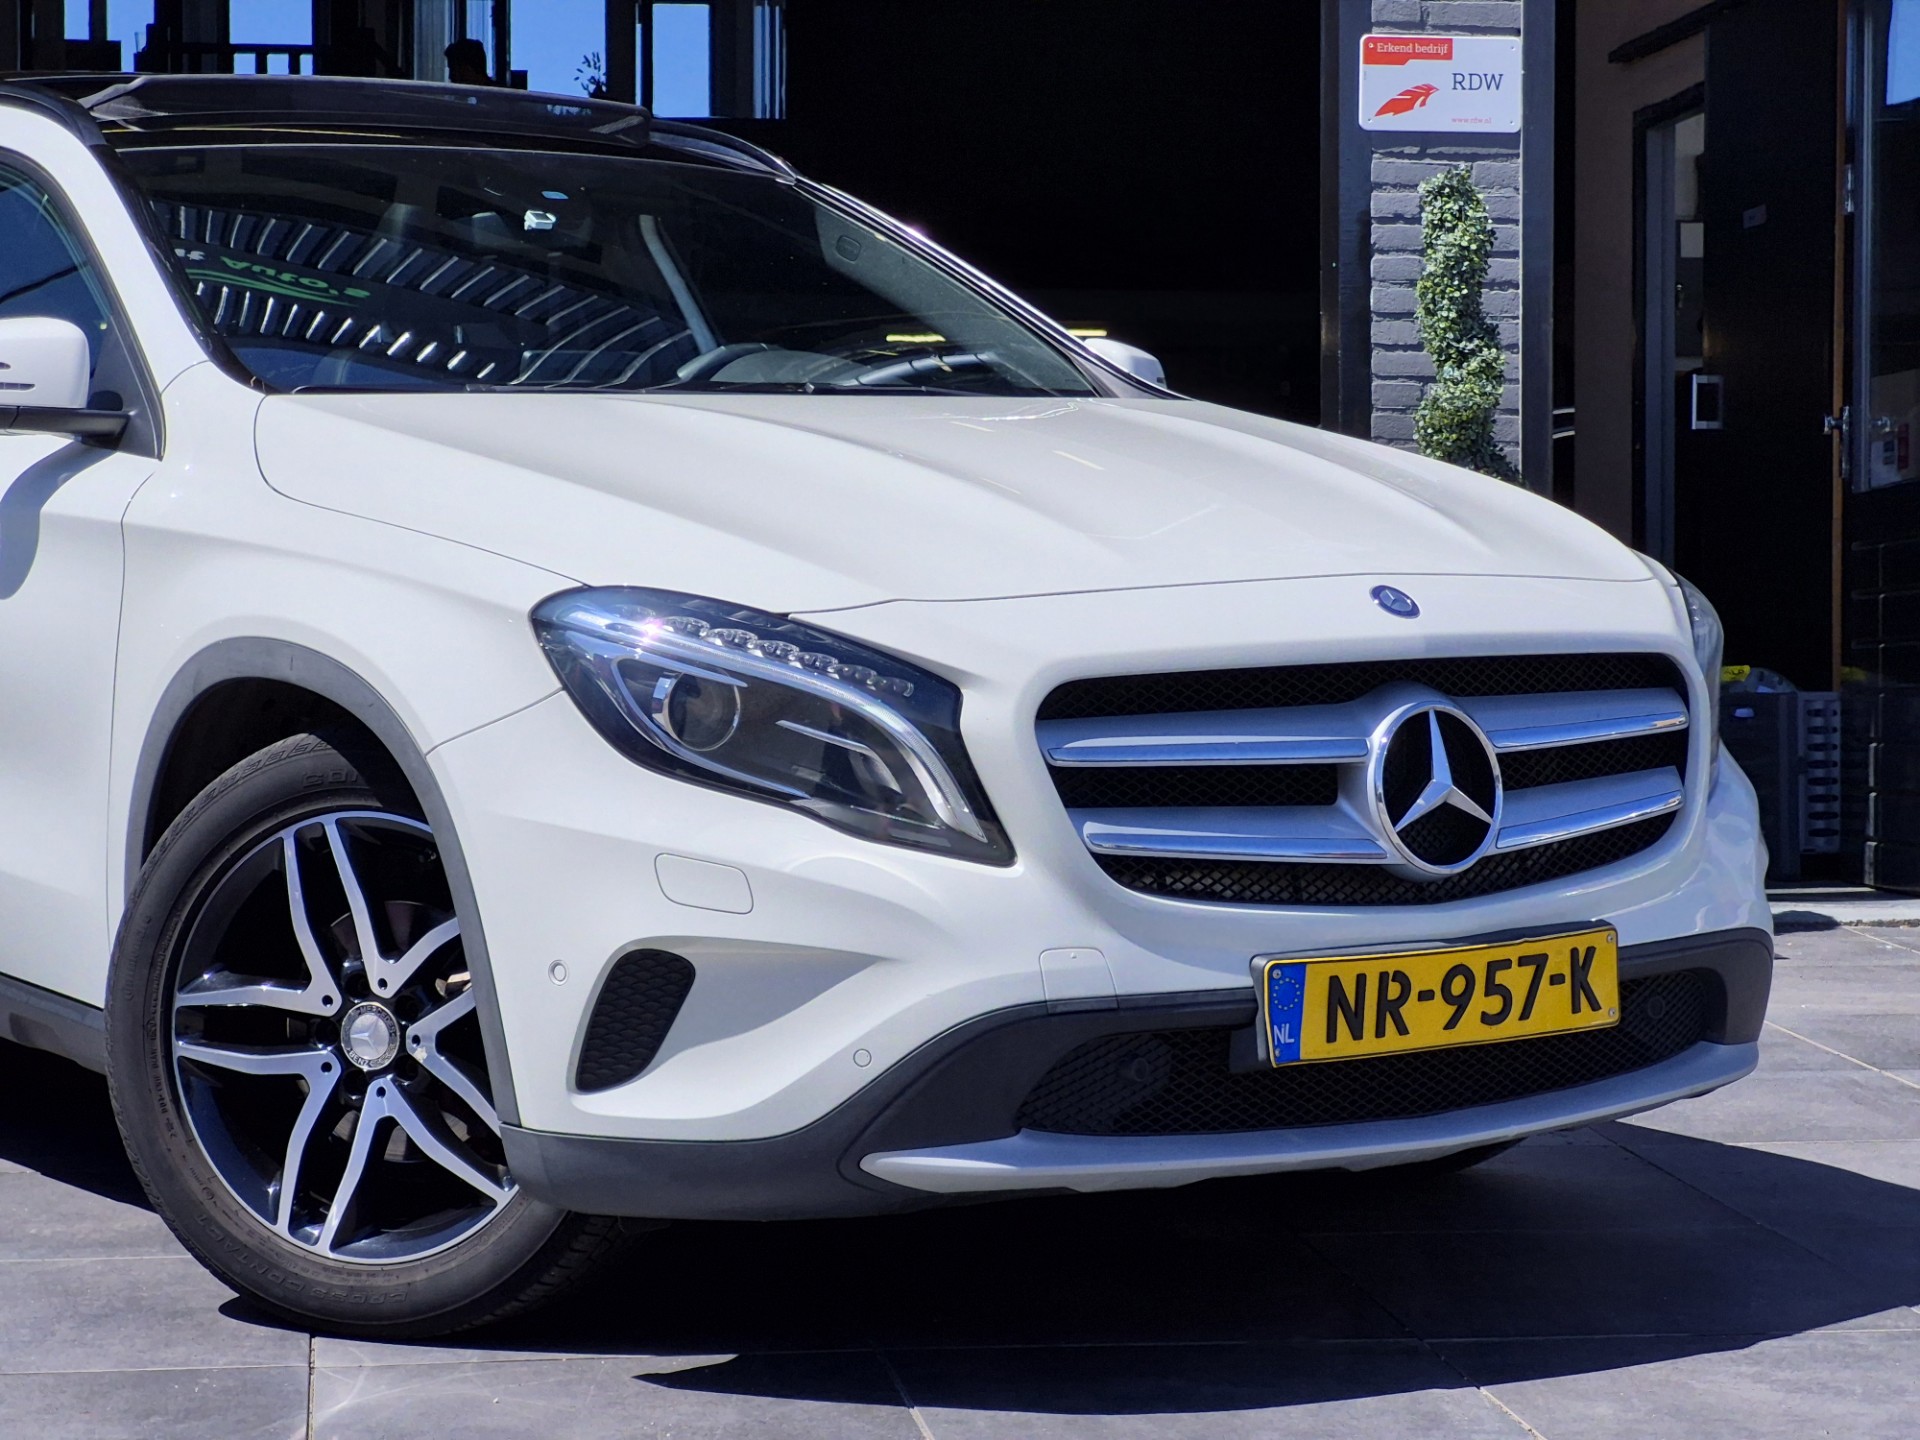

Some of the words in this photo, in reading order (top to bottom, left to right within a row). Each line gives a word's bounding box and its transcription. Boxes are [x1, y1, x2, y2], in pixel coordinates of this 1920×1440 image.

[1377, 42, 1413, 53] Erkend
[1415, 43, 1448, 55] bedrijf
[1452, 73, 1504, 91] RDW
[1326, 946, 1602, 1044] NR-957-K
[1273, 1023, 1295, 1046] NL
